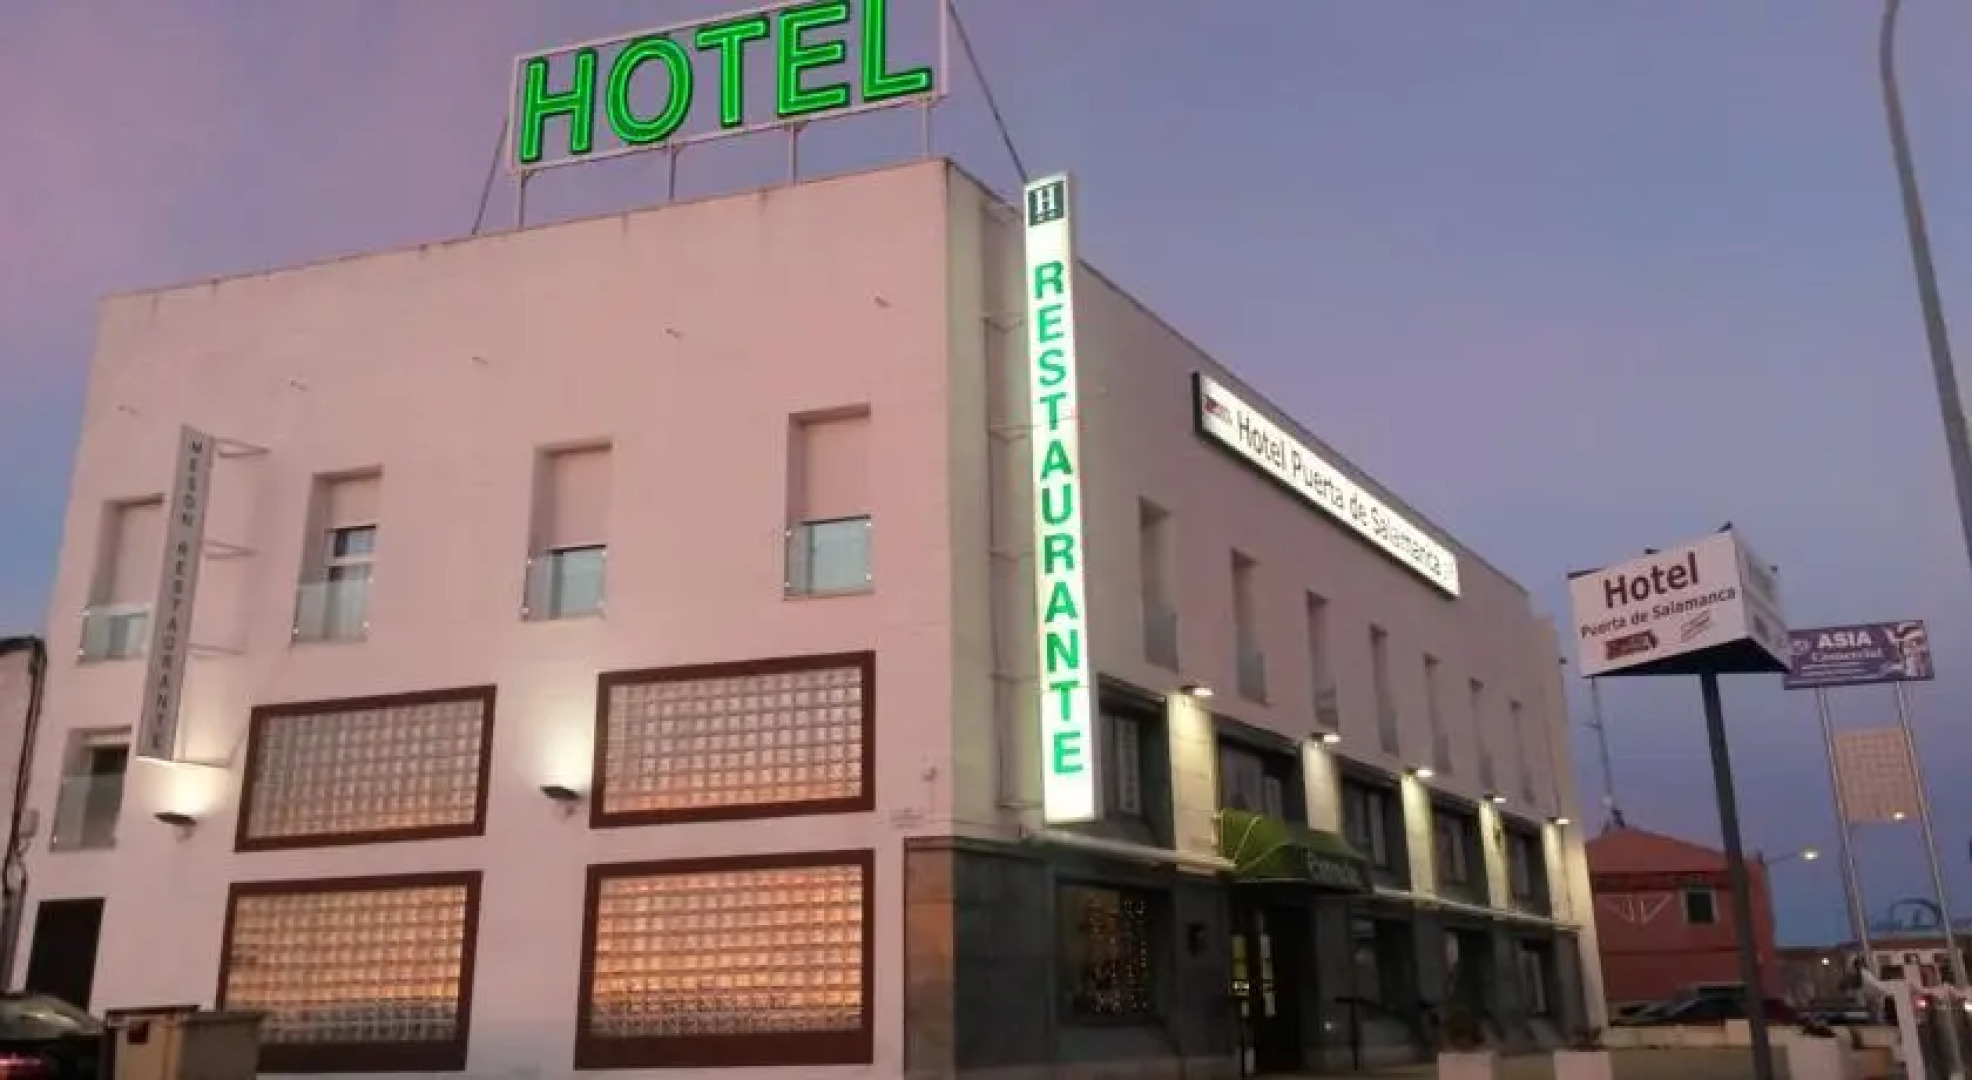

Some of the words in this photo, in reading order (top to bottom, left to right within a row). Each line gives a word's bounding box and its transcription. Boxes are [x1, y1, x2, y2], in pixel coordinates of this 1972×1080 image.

[519, 0, 933, 163] HOTEL
[1034, 261, 1083, 775] RESTAURANTE
[1237, 411, 1287, 470] Hotel
[1292, 450, 1343, 509] Puerta
[1350, 493, 1367, 527] de
[1371, 506, 1442, 576] Salamanca
[151, 540, 189, 749] RESTAURANTE
[1580, 616, 1627, 640] Puerta
[1631, 606, 1648, 625] de
[1652, 586, 1736, 619] Salamanca
[1604, 551, 1698, 609] Hotel
[1818, 631, 1872, 648] ASIA
